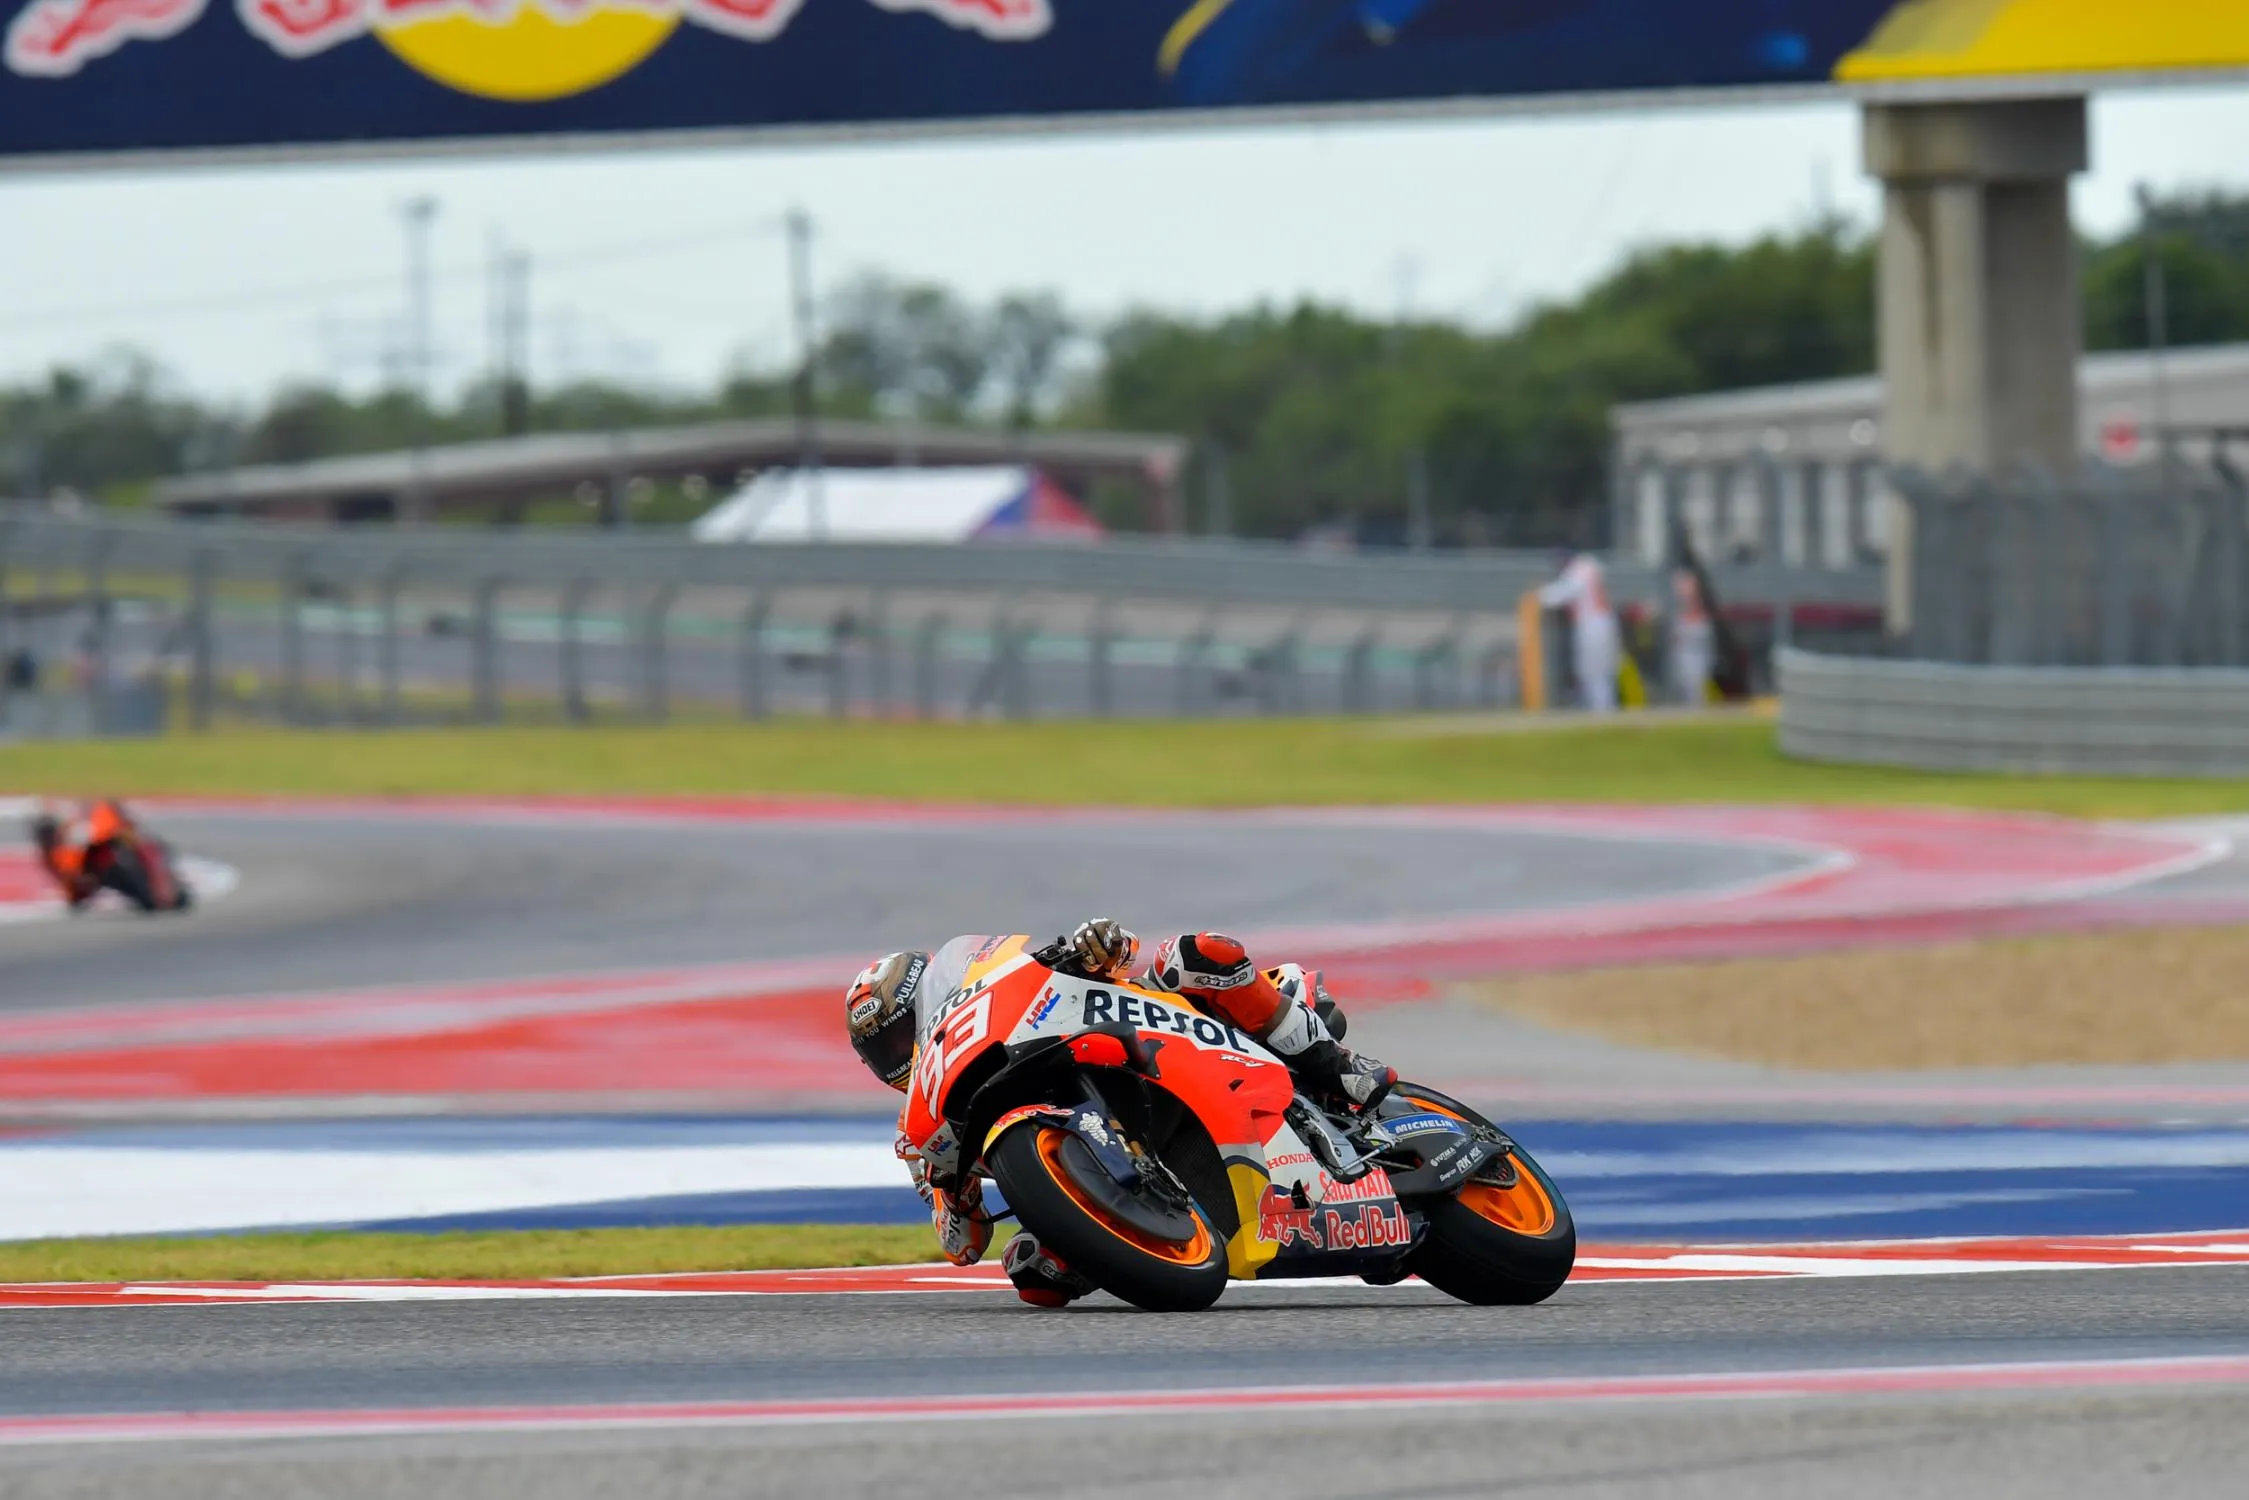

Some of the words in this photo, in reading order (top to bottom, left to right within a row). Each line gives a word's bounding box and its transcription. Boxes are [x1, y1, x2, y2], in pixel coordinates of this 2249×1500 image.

[853, 1000, 876, 1021] SHOEI
[881, 1007, 908, 1029] WINGS
[1082, 989, 1250, 1055] REPSOL
[919, 991, 994, 1122] 93
[1395, 1119, 1453, 1134] MICHELIN
[1265, 1152, 1315, 1170] HONDA
[1456, 1155, 1472, 1172] RK
[1325, 1204, 1371, 1251] Red
[1368, 1201, 1411, 1248] Bull
